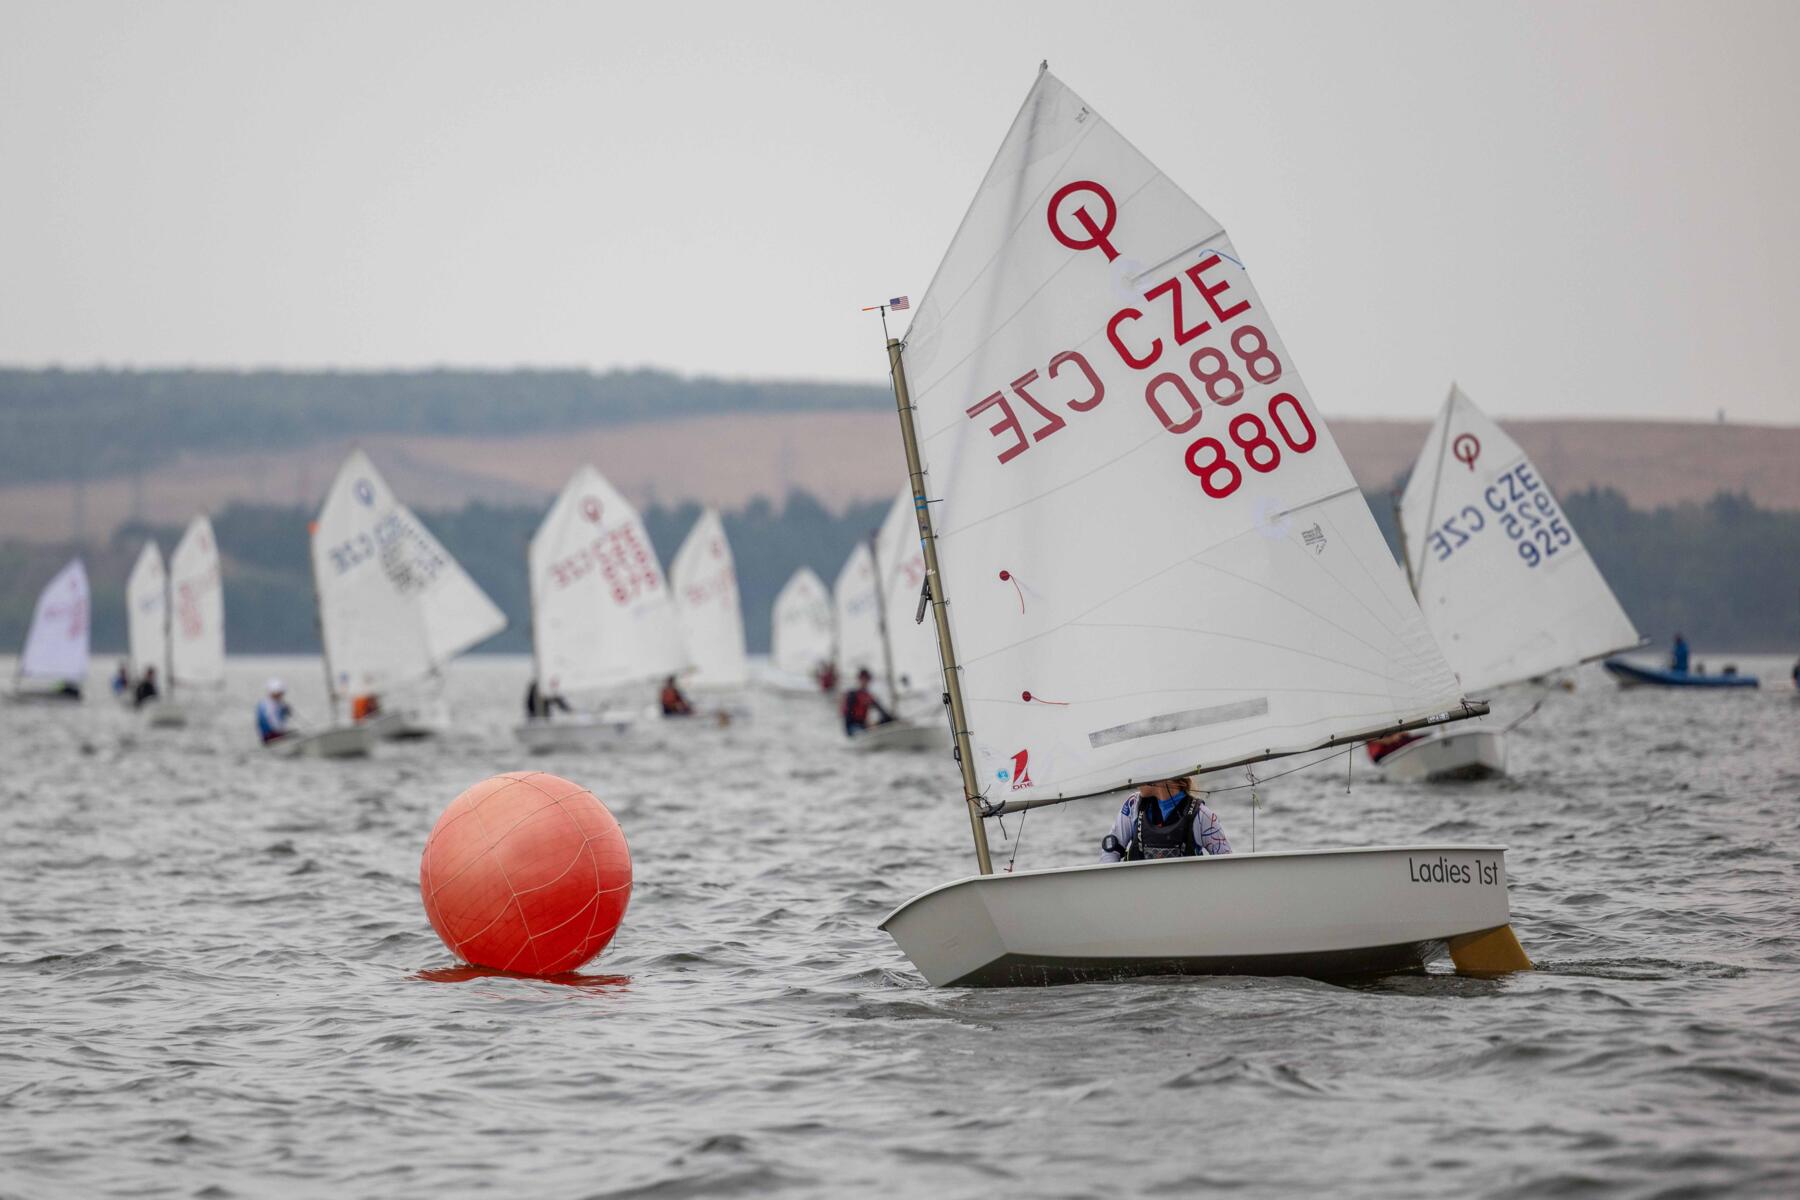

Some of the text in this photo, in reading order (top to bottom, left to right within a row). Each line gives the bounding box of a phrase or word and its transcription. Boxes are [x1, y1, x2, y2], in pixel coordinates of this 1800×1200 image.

[1106, 254, 1251, 370] CZE
[1184, 392, 1317, 499] 880
[1484, 462, 1539, 513] CZE
[1518, 518, 1571, 568] 925
[1409, 856, 1498, 885] Ladies 1st
